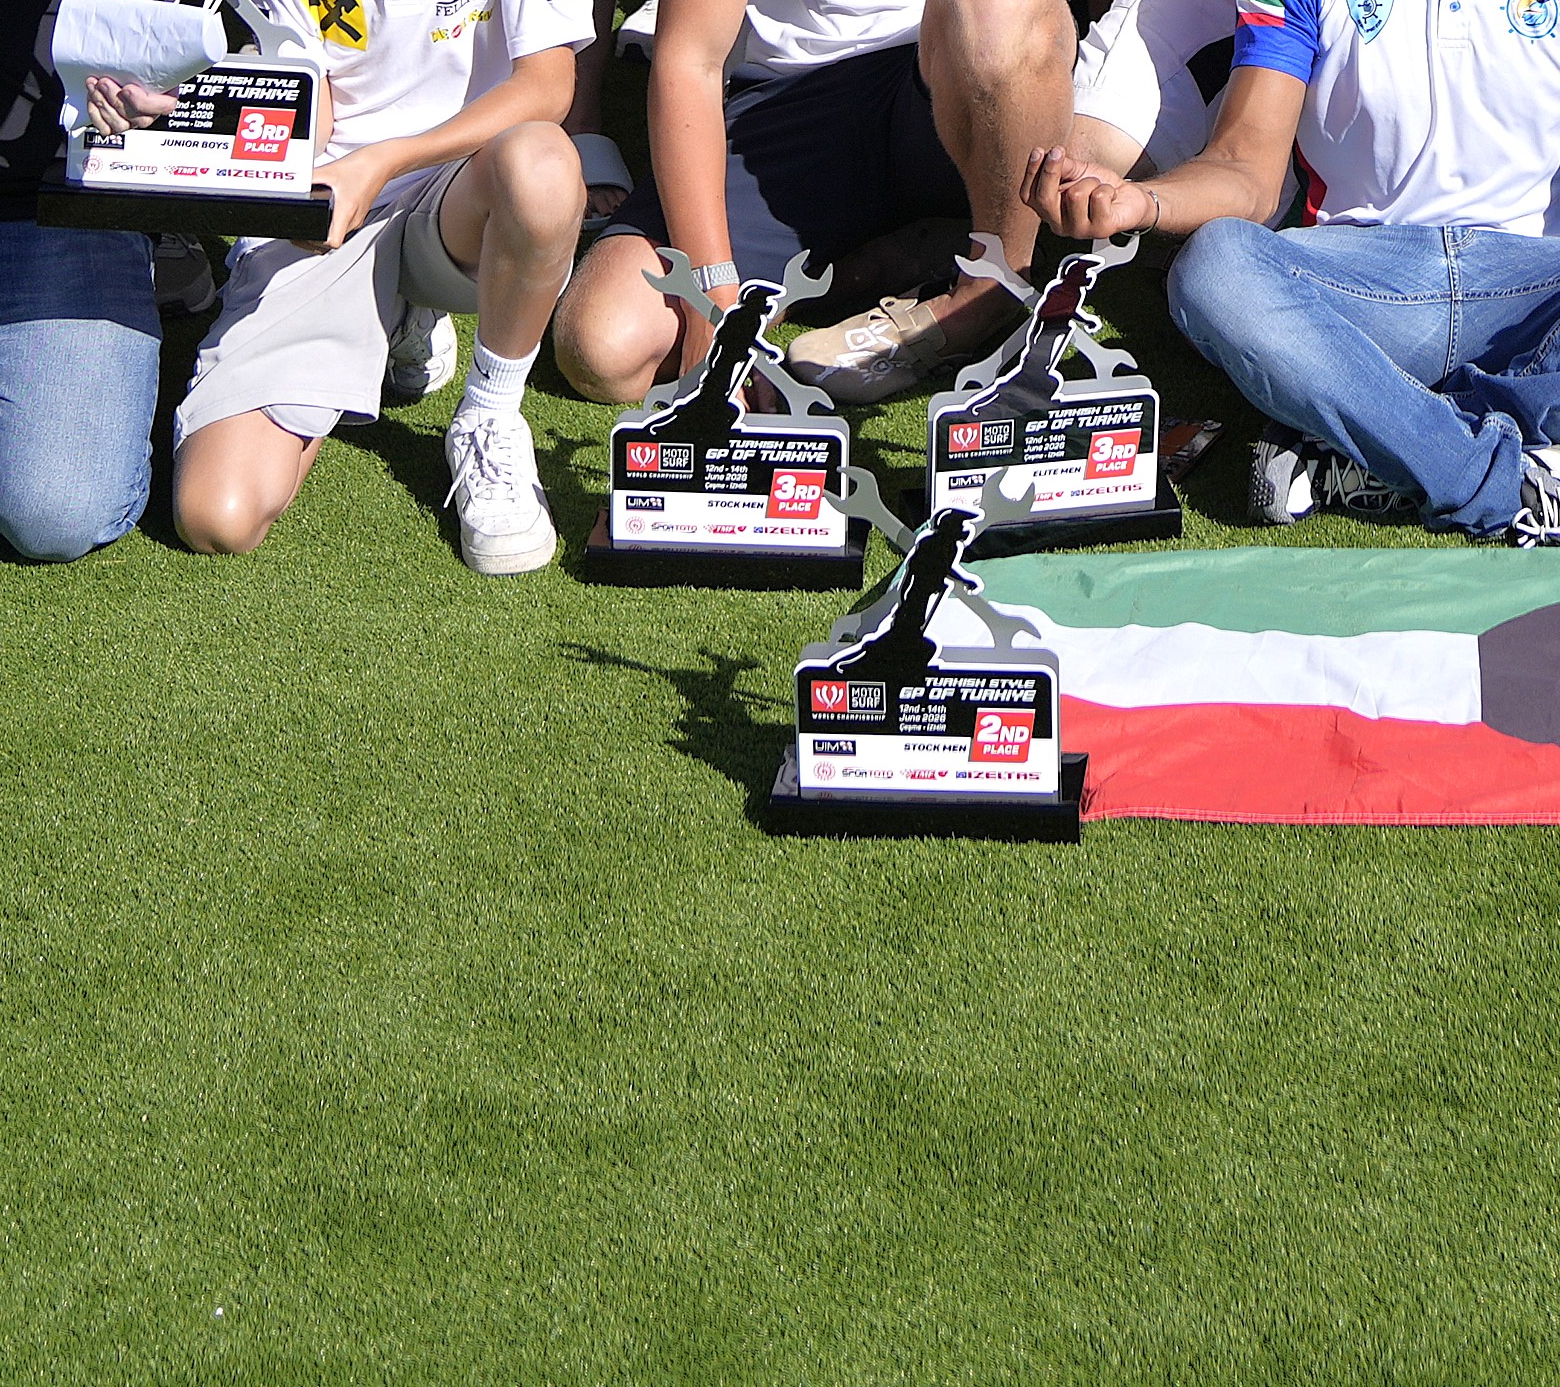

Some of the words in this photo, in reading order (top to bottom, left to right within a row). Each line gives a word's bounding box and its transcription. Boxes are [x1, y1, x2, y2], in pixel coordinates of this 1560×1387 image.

[240, 113, 290, 141] 3RD
[160, 138, 199, 149] JUNIOR
[200, 140, 229, 150] BOYS
[243, 142, 279, 153] PLACE
[1090, 436, 1137, 463] 3RD
[1095, 461, 1128, 473] PLACE
[773, 474, 822, 501] 3RD
[707, 500, 741, 510] STOCK
[742, 500, 765, 510] MEN
[778, 501, 811, 512] PLACE
[763, 526, 831, 536] IZELTAS
[976, 714, 1030, 744] 2ND
[903, 742, 941, 752] STOCK
[942, 743, 967, 752] MEN
[982, 743, 1020, 756] PLACE
